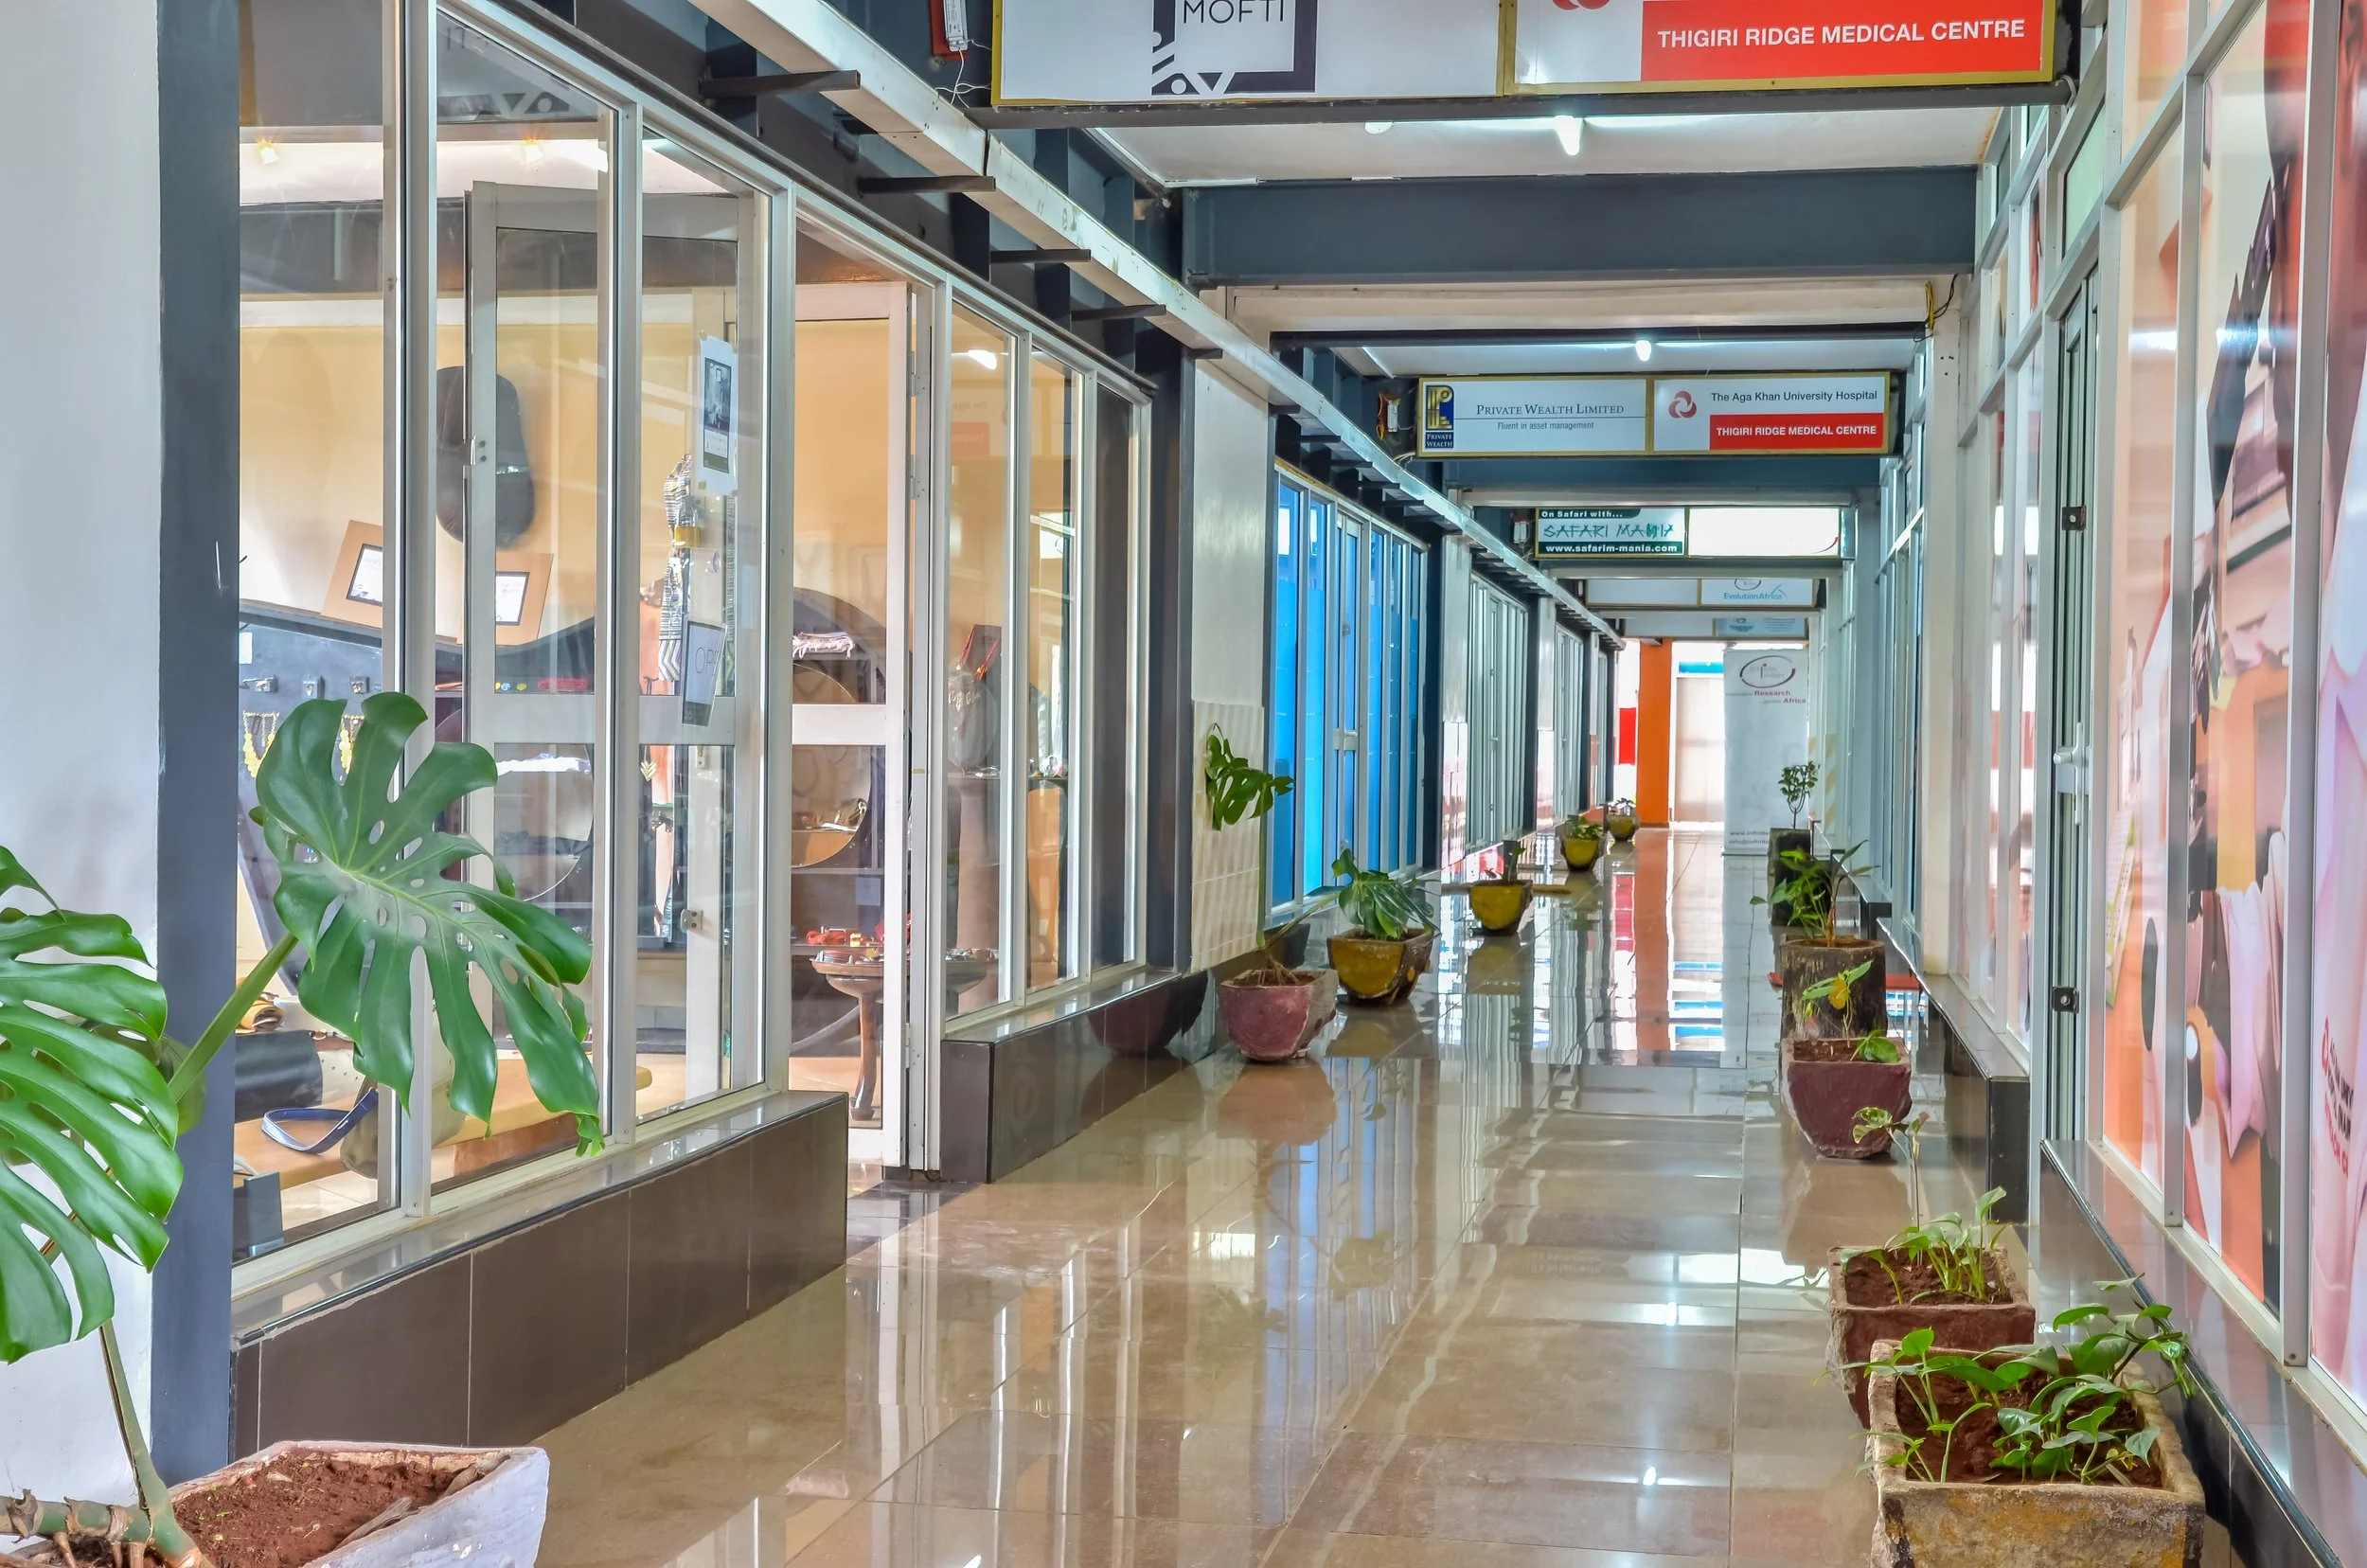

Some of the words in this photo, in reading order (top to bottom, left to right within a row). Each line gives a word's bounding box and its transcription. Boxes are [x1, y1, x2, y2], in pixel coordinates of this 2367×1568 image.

[1184, 0, 1284, 24] MOFTI
[1657, 29, 1739, 49] THIGIRI
[1745, 27, 1815, 47] RIDGE
[1822, 22, 1925, 45] MEDICAL
[1931, 19, 2025, 41] CENTRE
[1711, 392, 1730, 401] The
[1732, 392, 1752, 403] Aga
[1754, 391, 1781, 401] Khan
[1783, 391, 1833, 402] University
[1836, 390, 1878, 402] Hospital
[1476, 404, 1522, 416] PRIVATE
[1524, 404, 1573, 415] WEALTH
[1576, 403, 1624, 415] LIMITED
[1497, 421, 1519, 431] Fluent
[1520, 421, 1527, 430] in
[1549, 421, 1594, 432] management
[1716, 427, 1753, 437] THIGIRI
[1754, 427, 1786, 437] RIDGE
[1788, 426, 1833, 436] MEDICAL
[1836, 426, 1877, 435] CENTRE
[1543, 524, 1609, 538] SAFARI
[1616, 523, 1674, 539] MANIA
[1723, 592, 1783, 600] EvolutionAfrica
